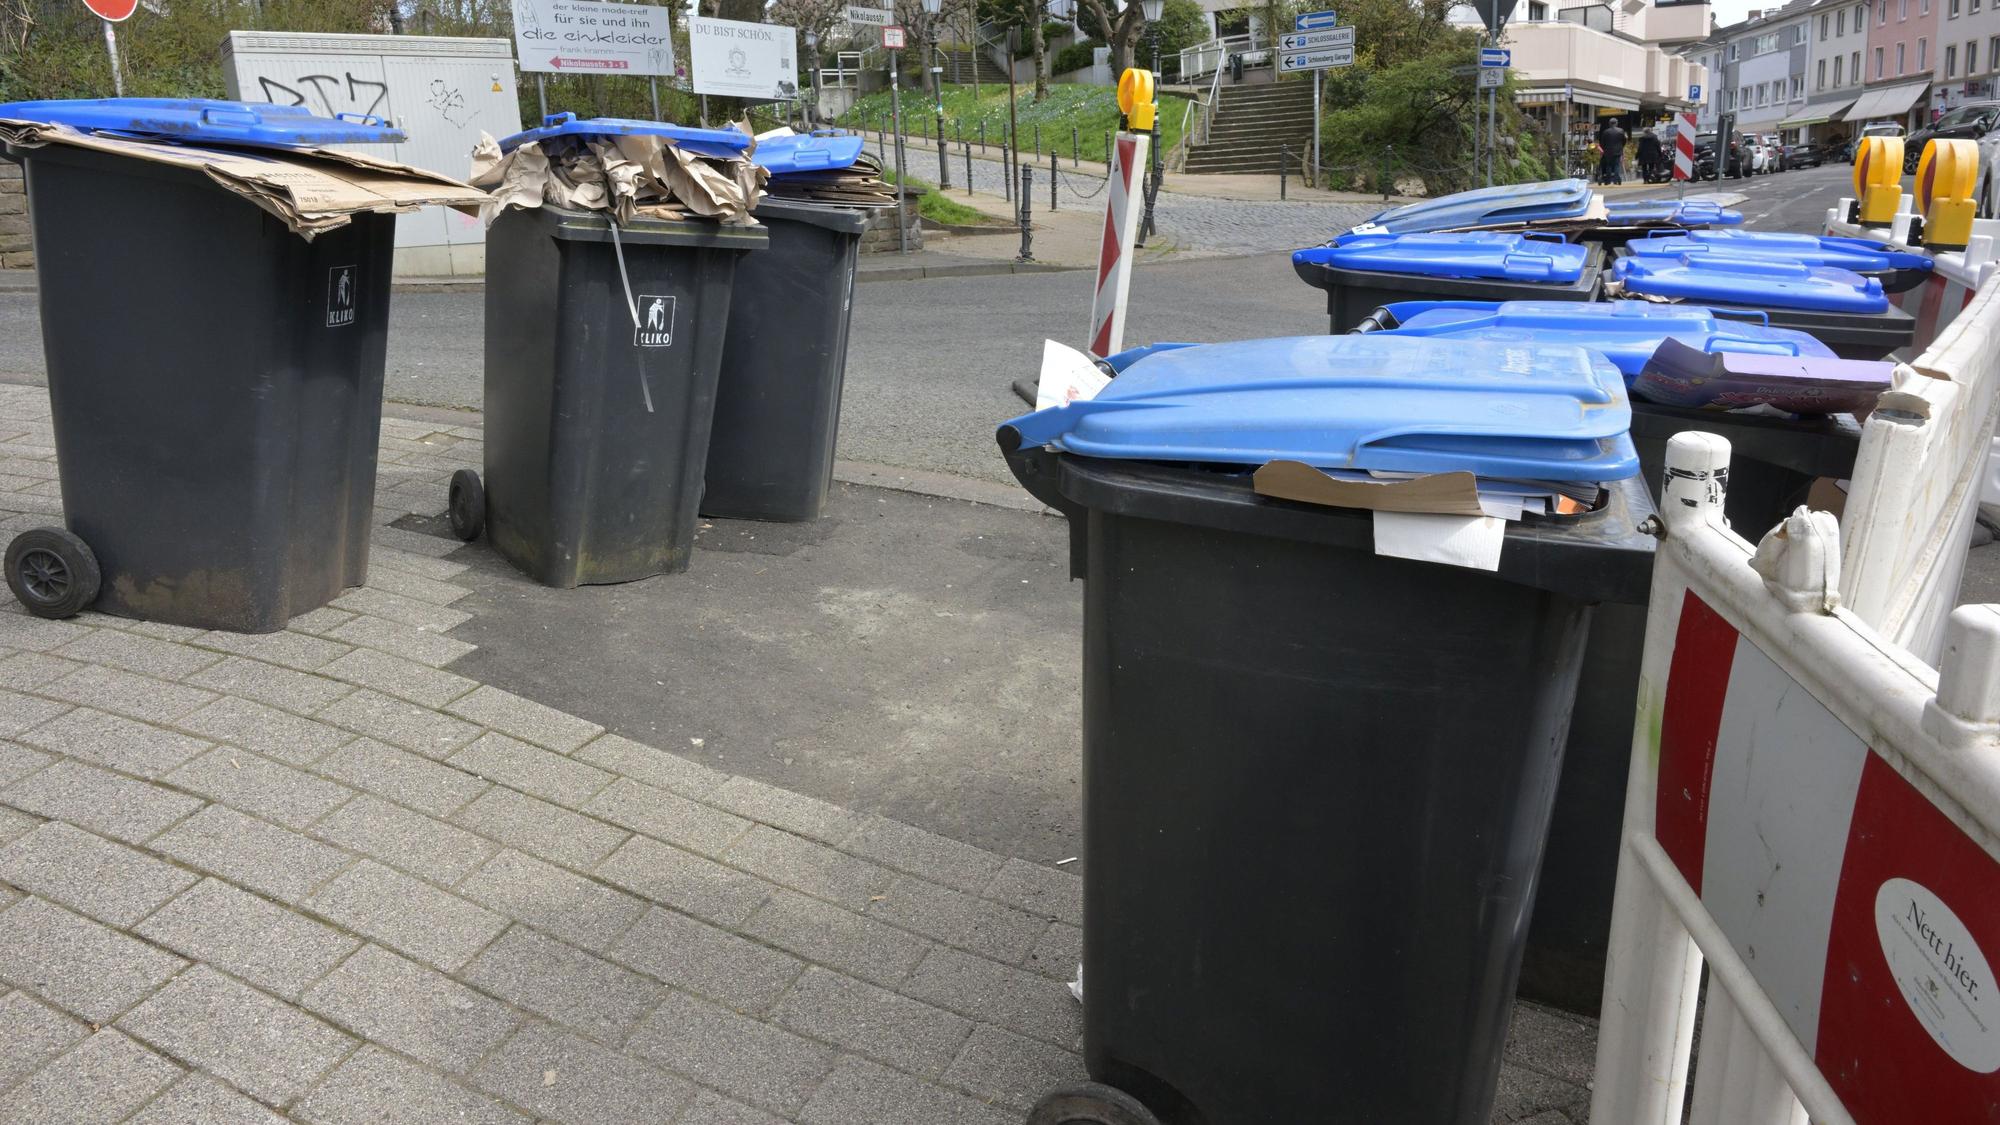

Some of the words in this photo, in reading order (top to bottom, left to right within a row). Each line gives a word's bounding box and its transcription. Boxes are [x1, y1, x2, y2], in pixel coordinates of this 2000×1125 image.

[552, 3, 569, 11] der
[572, 4, 599, 13] kleine
[602, 7, 648, 15] mode-treff
[554, 13, 573, 24] für
[579, 16, 597, 25] sie
[602, 17, 626, 27] und
[631, 18, 650, 28] ihn
[522, 27, 557, 40] die
[564, 30, 666, 45] einkleider
[695, 23, 711, 35] DU
[713, 26, 736, 37] BIST
[737, 28, 774, 41] SCHÖN.
[1308, 32, 1349, 43] SCHLOSSGALERIE
[1334, 53, 1350, 61] Garage
[329, 308, 353, 324] KLIKO
[1906, 898, 1943, 956] Nett
[1944, 942, 1978, 1002] hier.
